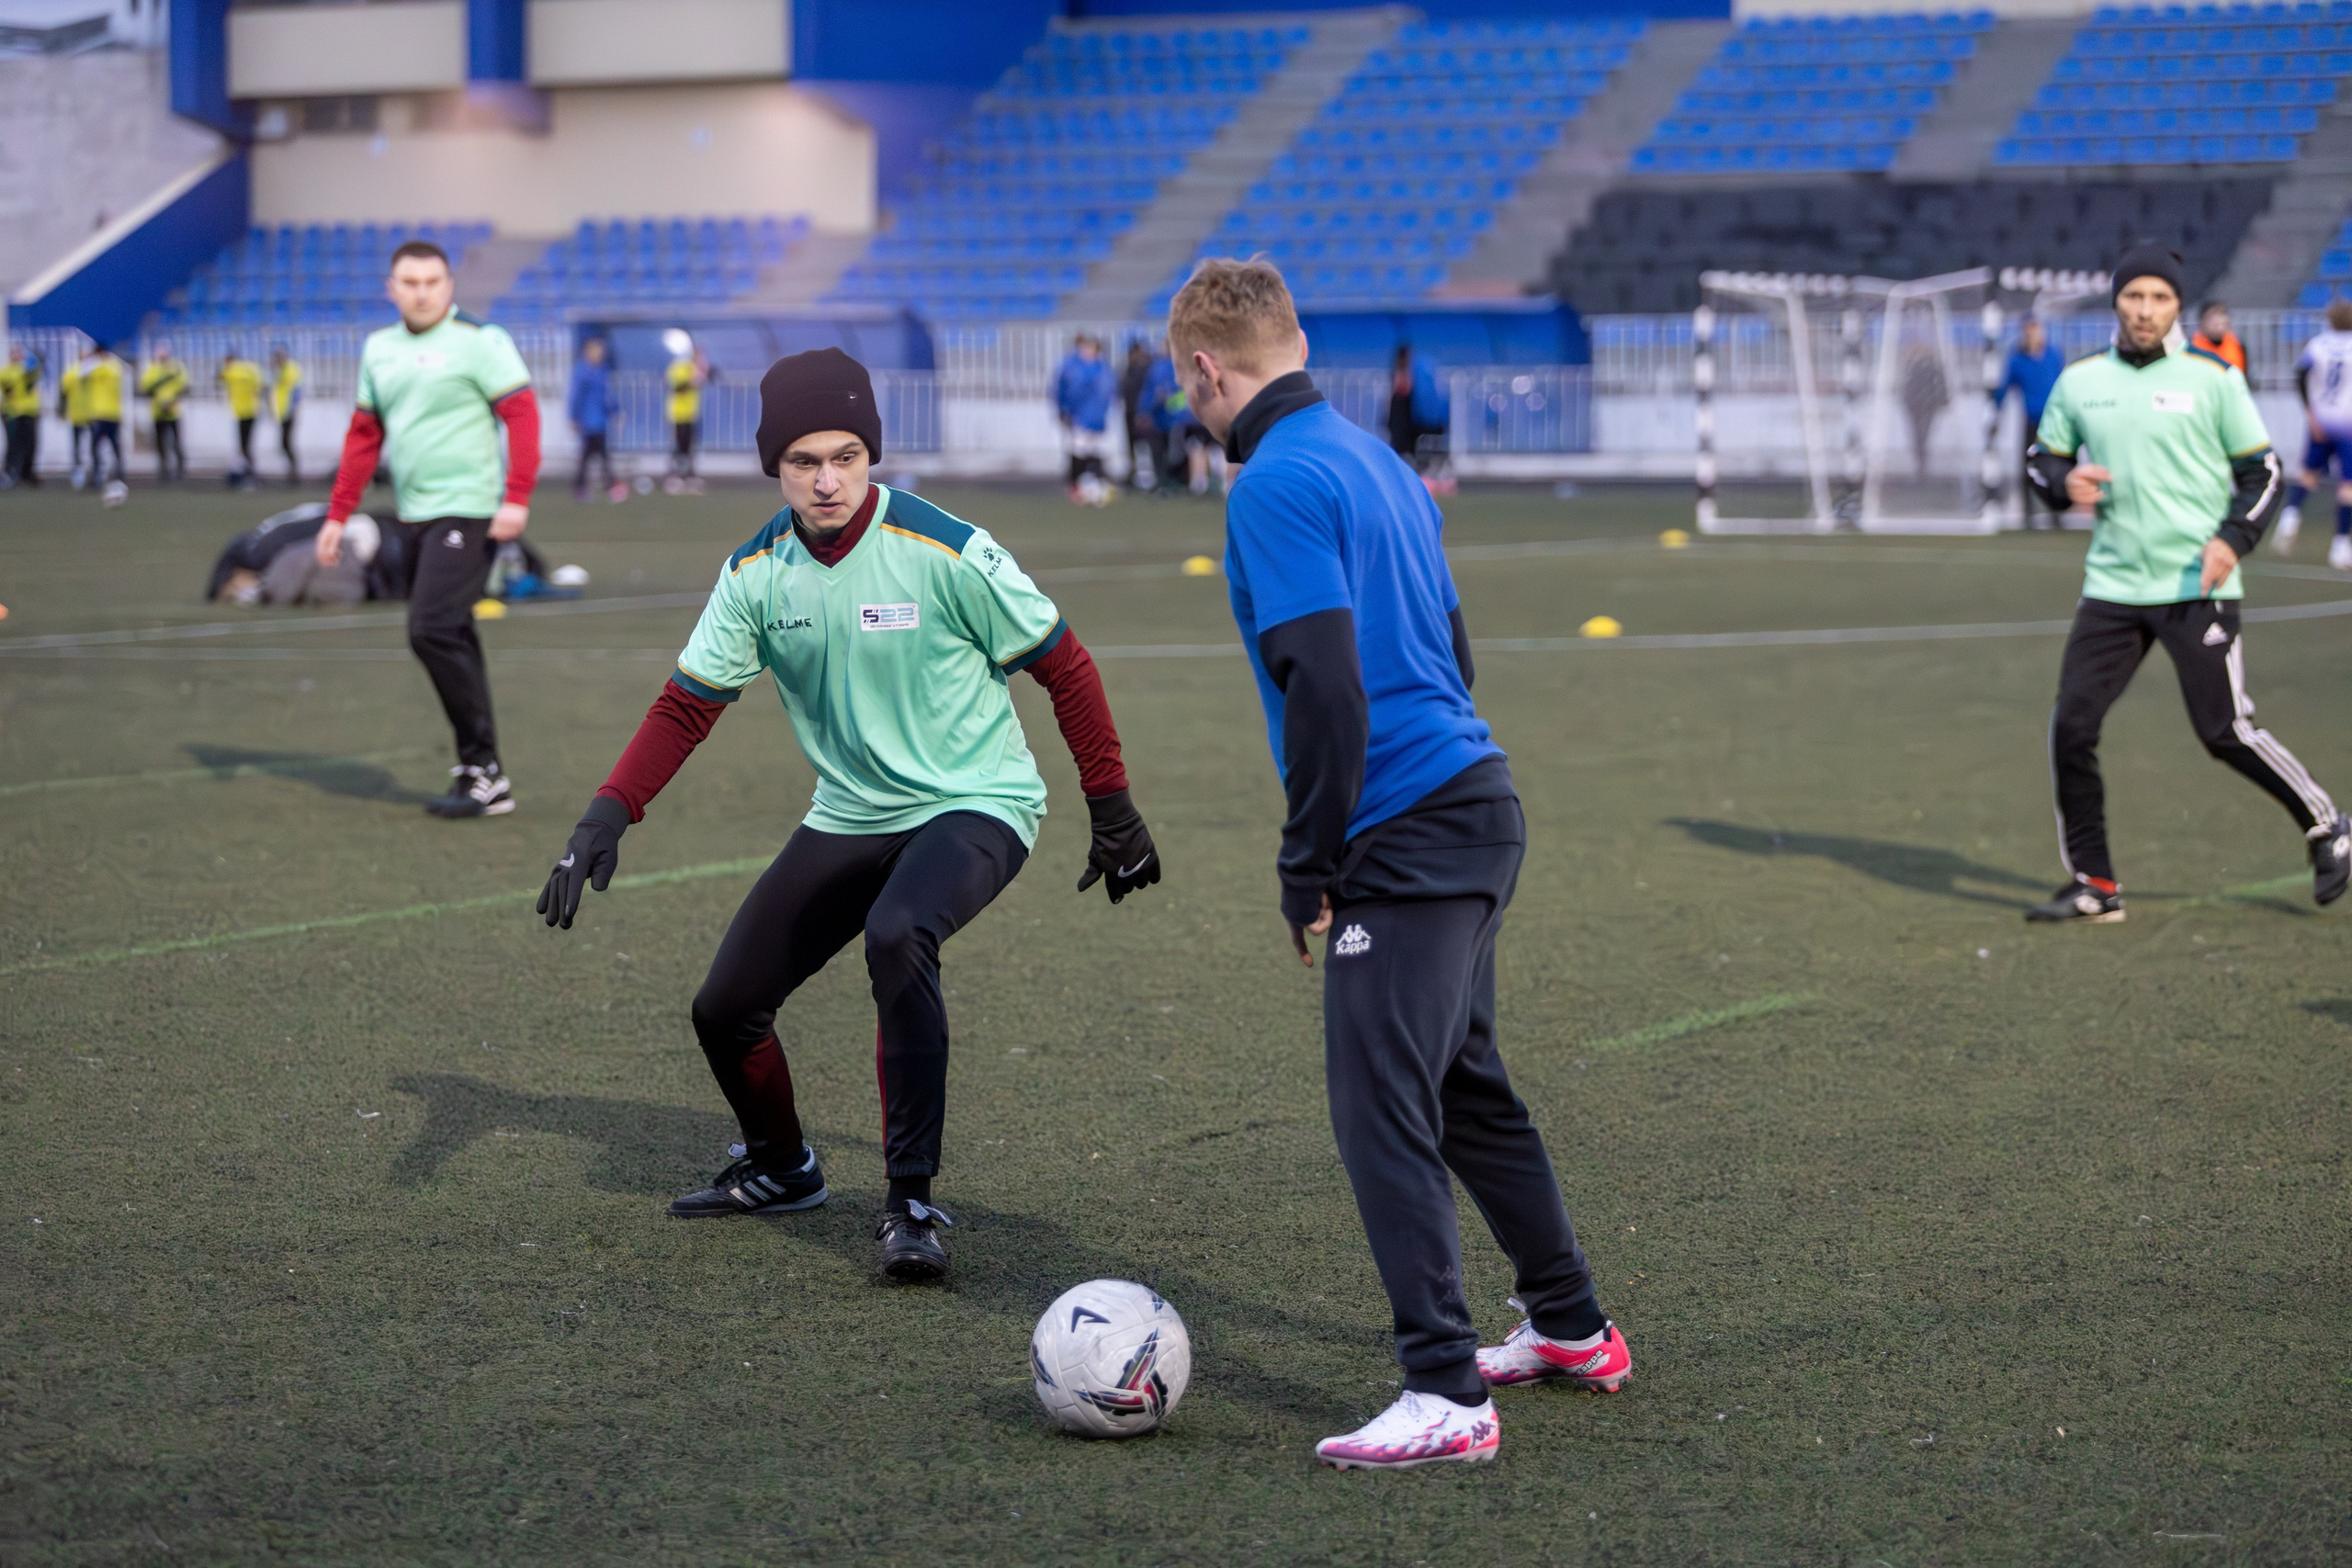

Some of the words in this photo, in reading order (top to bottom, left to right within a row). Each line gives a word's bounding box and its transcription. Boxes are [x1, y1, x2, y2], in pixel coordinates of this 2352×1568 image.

[863, 607, 915, 624] S22
[766, 618, 813, 632] KELME
[1336, 940, 1370, 954] Kappa
